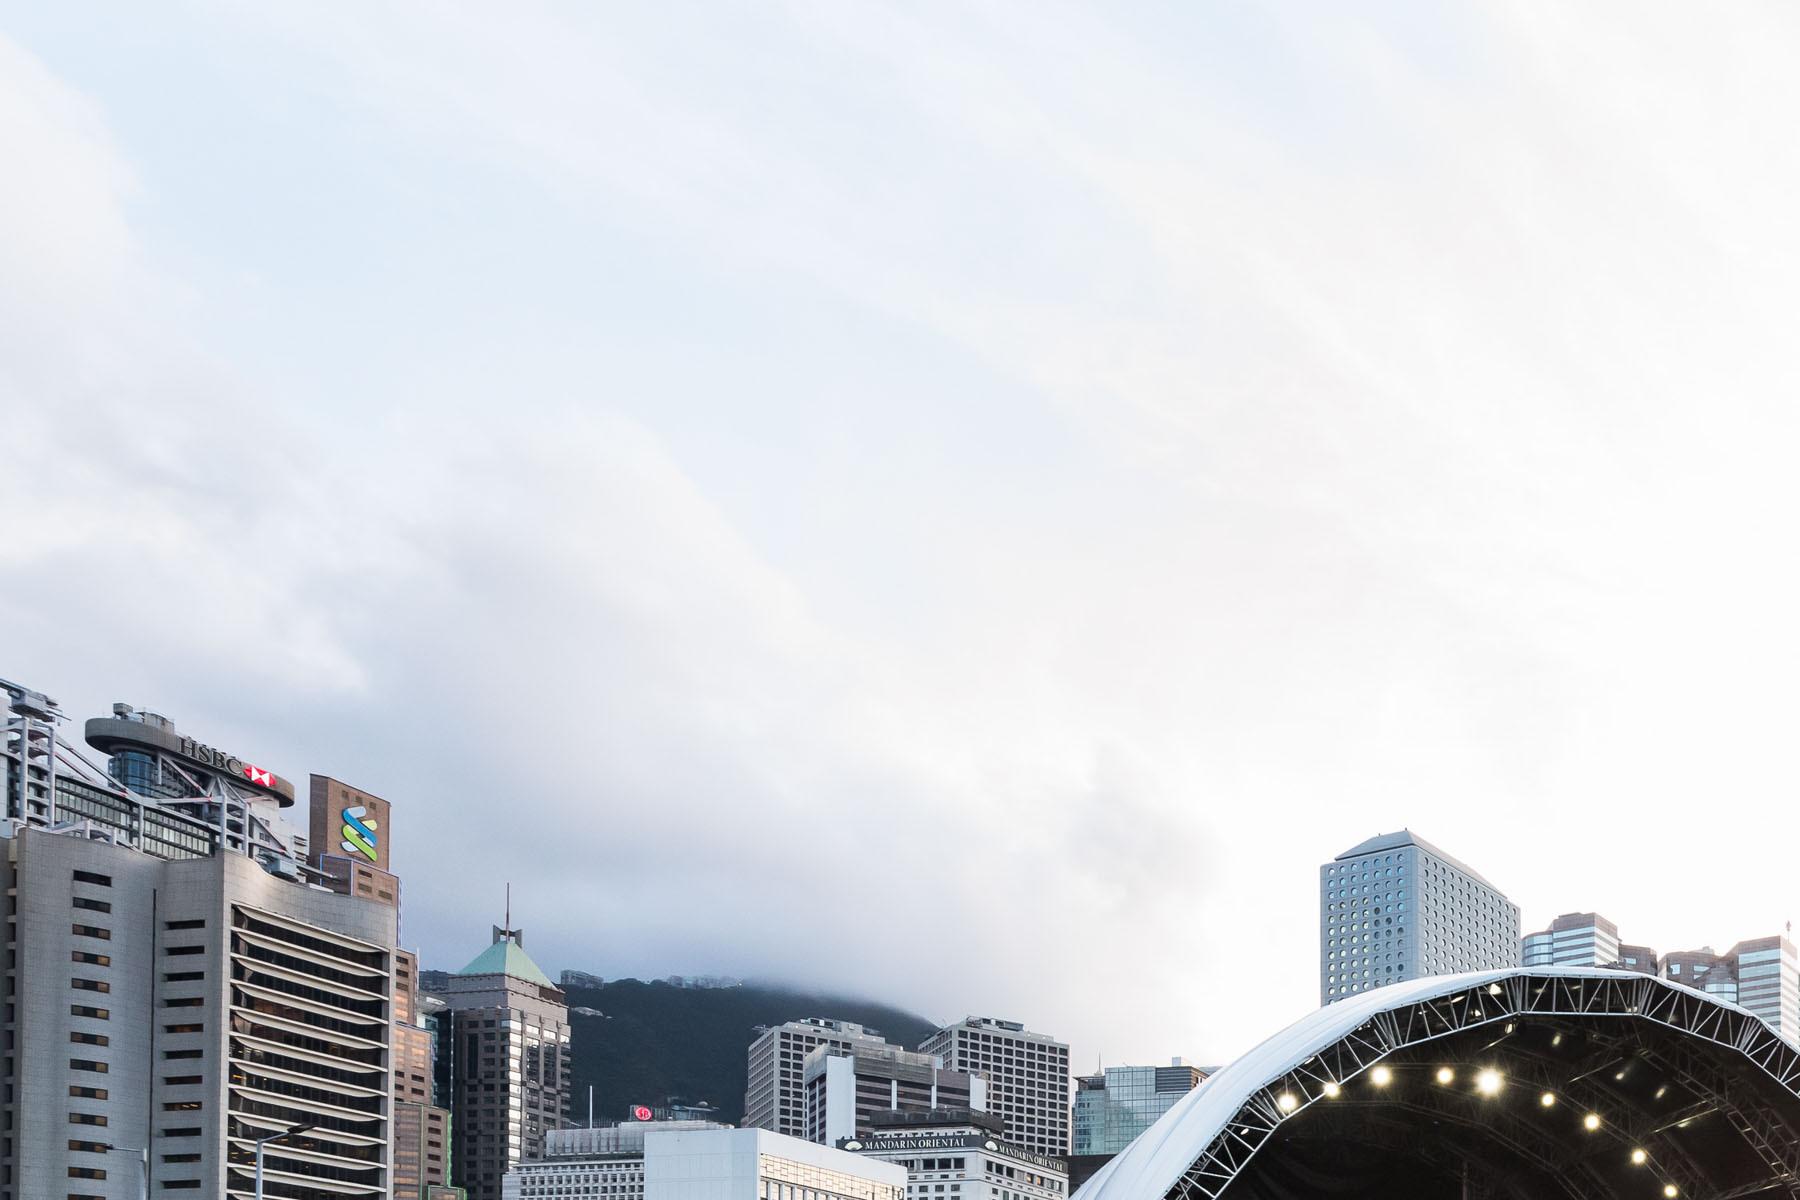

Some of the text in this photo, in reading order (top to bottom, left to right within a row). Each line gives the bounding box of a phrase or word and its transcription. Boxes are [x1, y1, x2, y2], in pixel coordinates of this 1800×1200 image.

[180, 737, 243, 775] HSBC
[865, 1138, 966, 1150] MANDARIN ORIENTAL
[999, 1144, 1063, 1172] MANDARIN ORIENTAL
